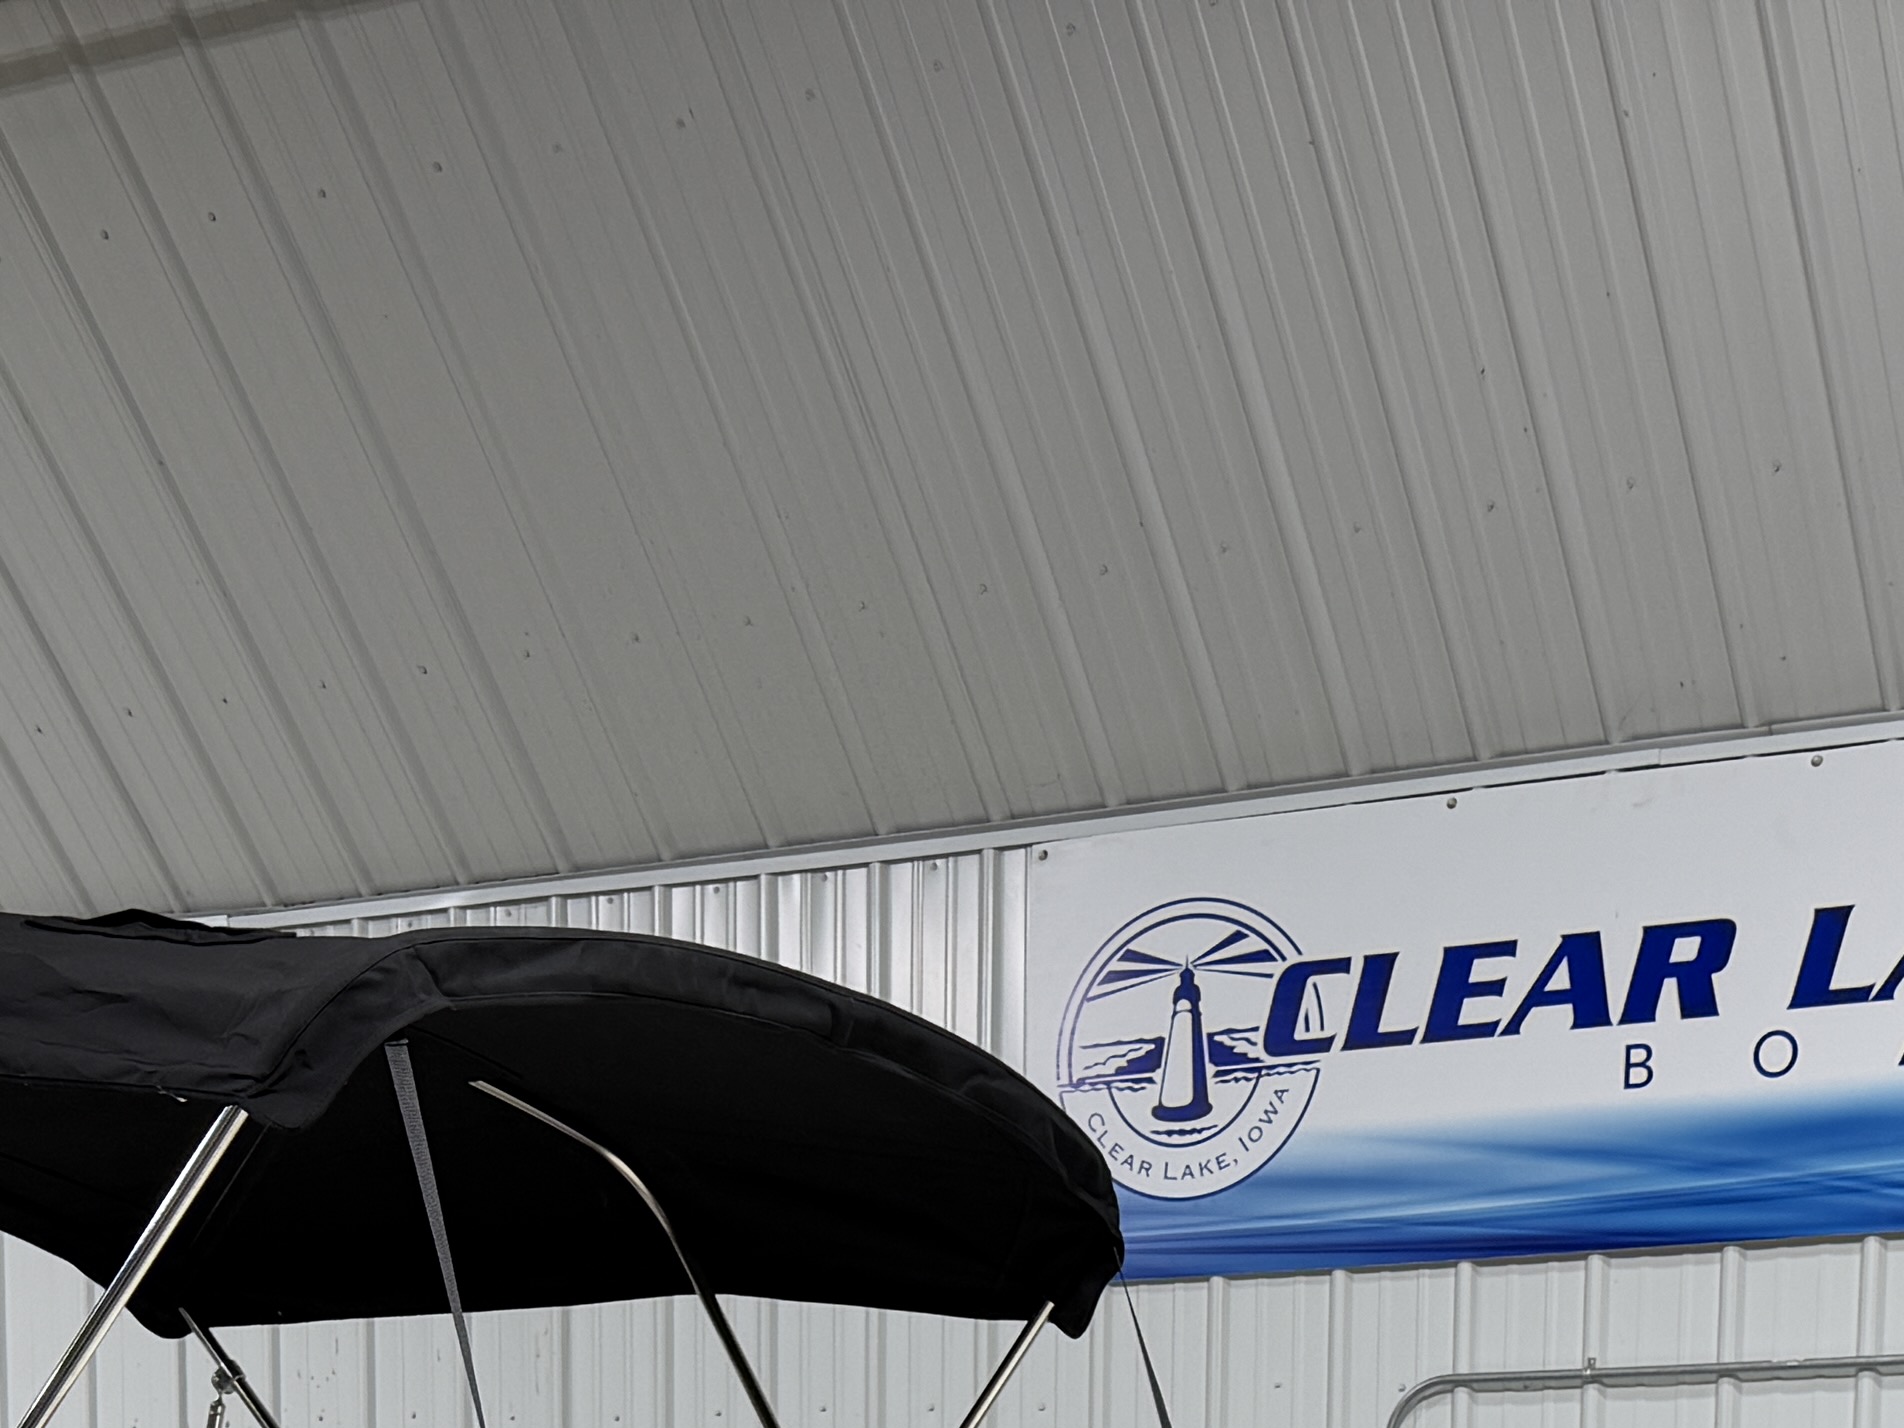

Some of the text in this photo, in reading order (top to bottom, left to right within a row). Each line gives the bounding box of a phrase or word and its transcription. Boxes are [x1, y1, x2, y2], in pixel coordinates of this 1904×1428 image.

[1262, 918, 1738, 1059] CLEAR
[1087, 1086, 1290, 1181] CLEAR LAKE, IOWA
